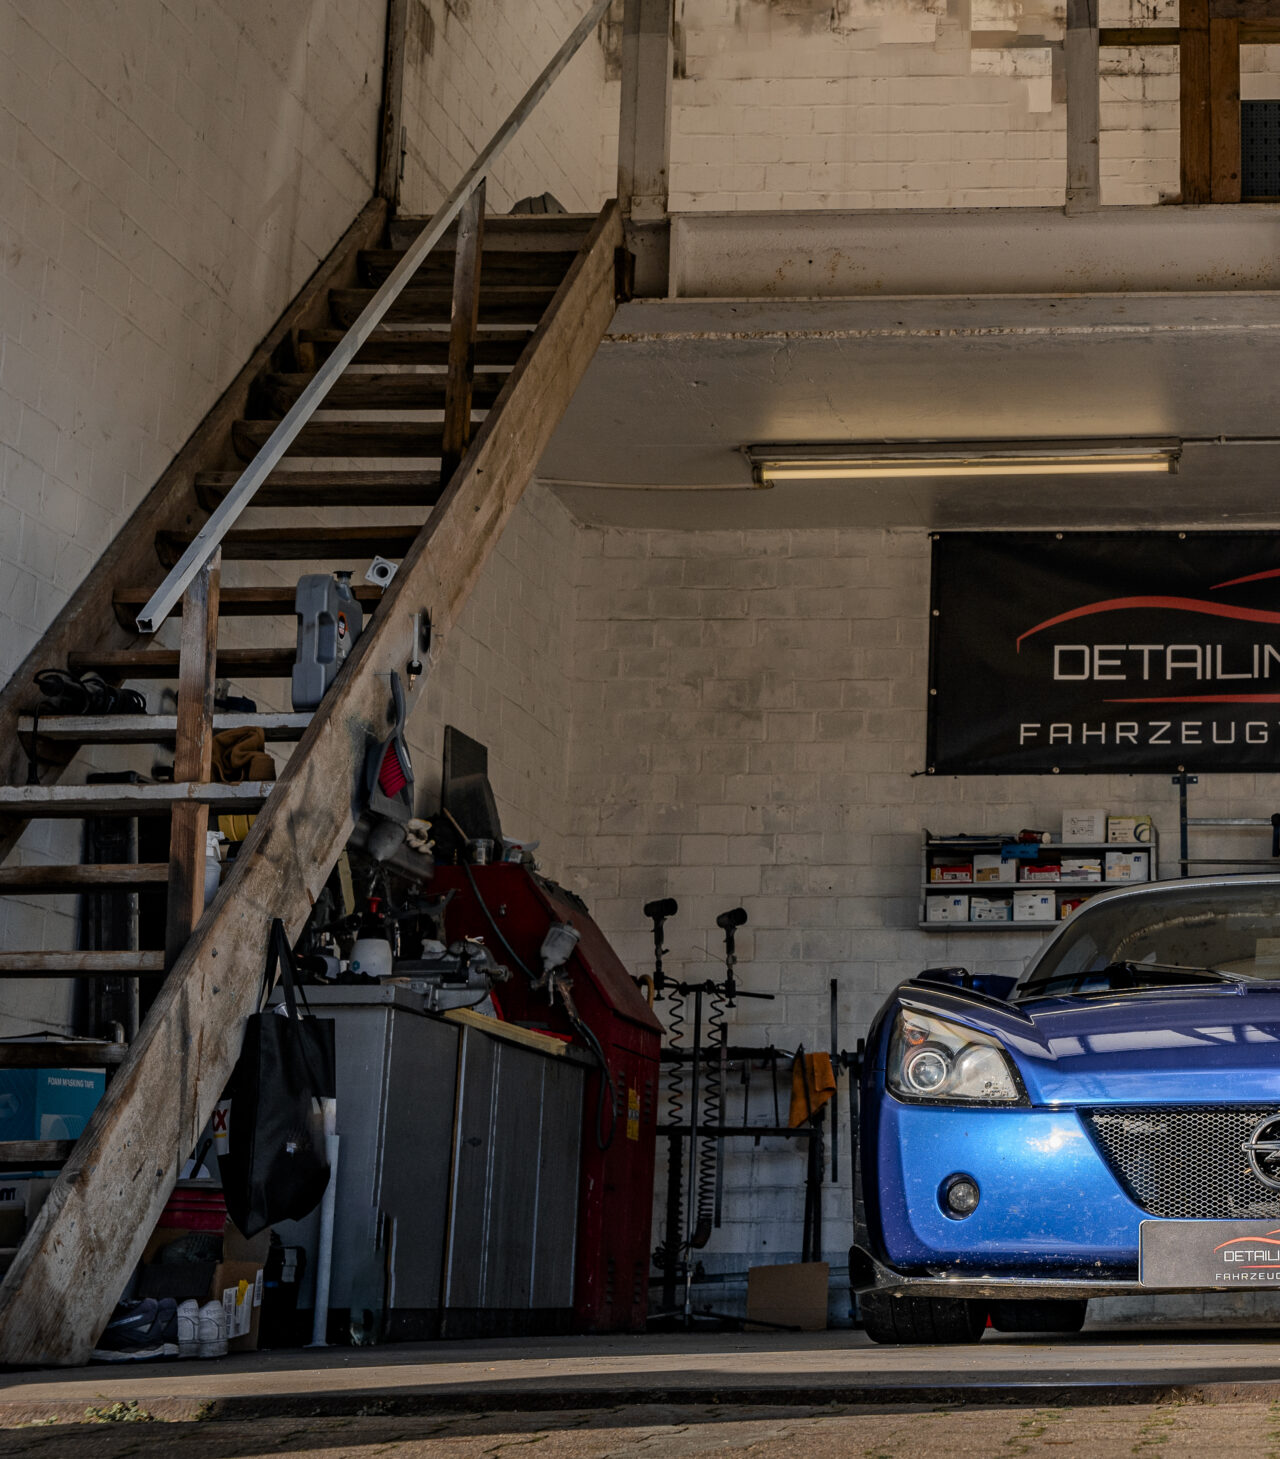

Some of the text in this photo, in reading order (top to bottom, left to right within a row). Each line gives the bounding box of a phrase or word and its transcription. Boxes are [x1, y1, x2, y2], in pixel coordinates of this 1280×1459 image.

[47, 1077, 95, 1089] FOAM MASKING TAPE
